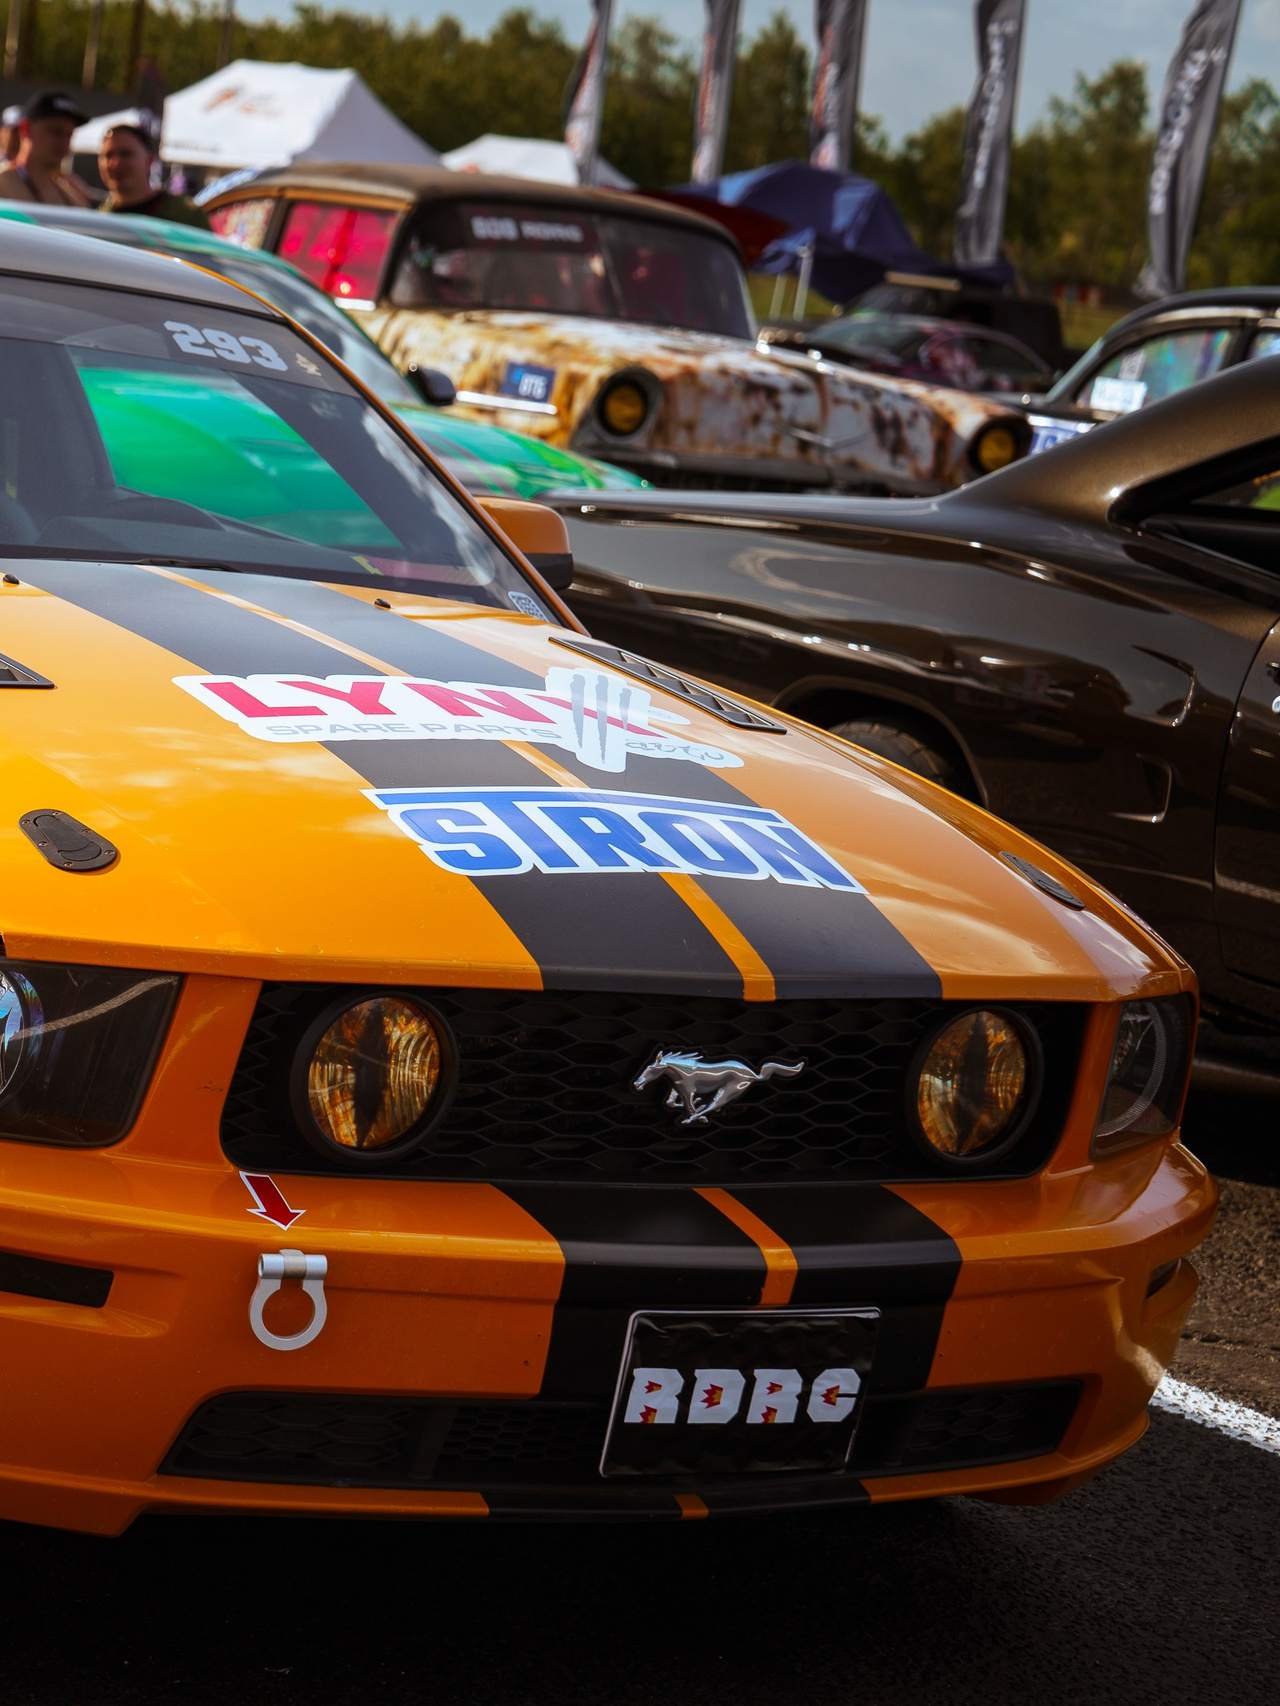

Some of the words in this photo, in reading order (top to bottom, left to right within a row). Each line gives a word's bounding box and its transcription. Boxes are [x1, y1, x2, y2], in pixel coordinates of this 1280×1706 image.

[163, 320, 288, 371] 293
[200, 681, 668, 739] LYNX
[265, 722, 419, 737] SPARE
[419, 724, 564, 740] PARTS
[375, 790, 857, 888] STRON
[624, 1367, 862, 1424] RDRC
